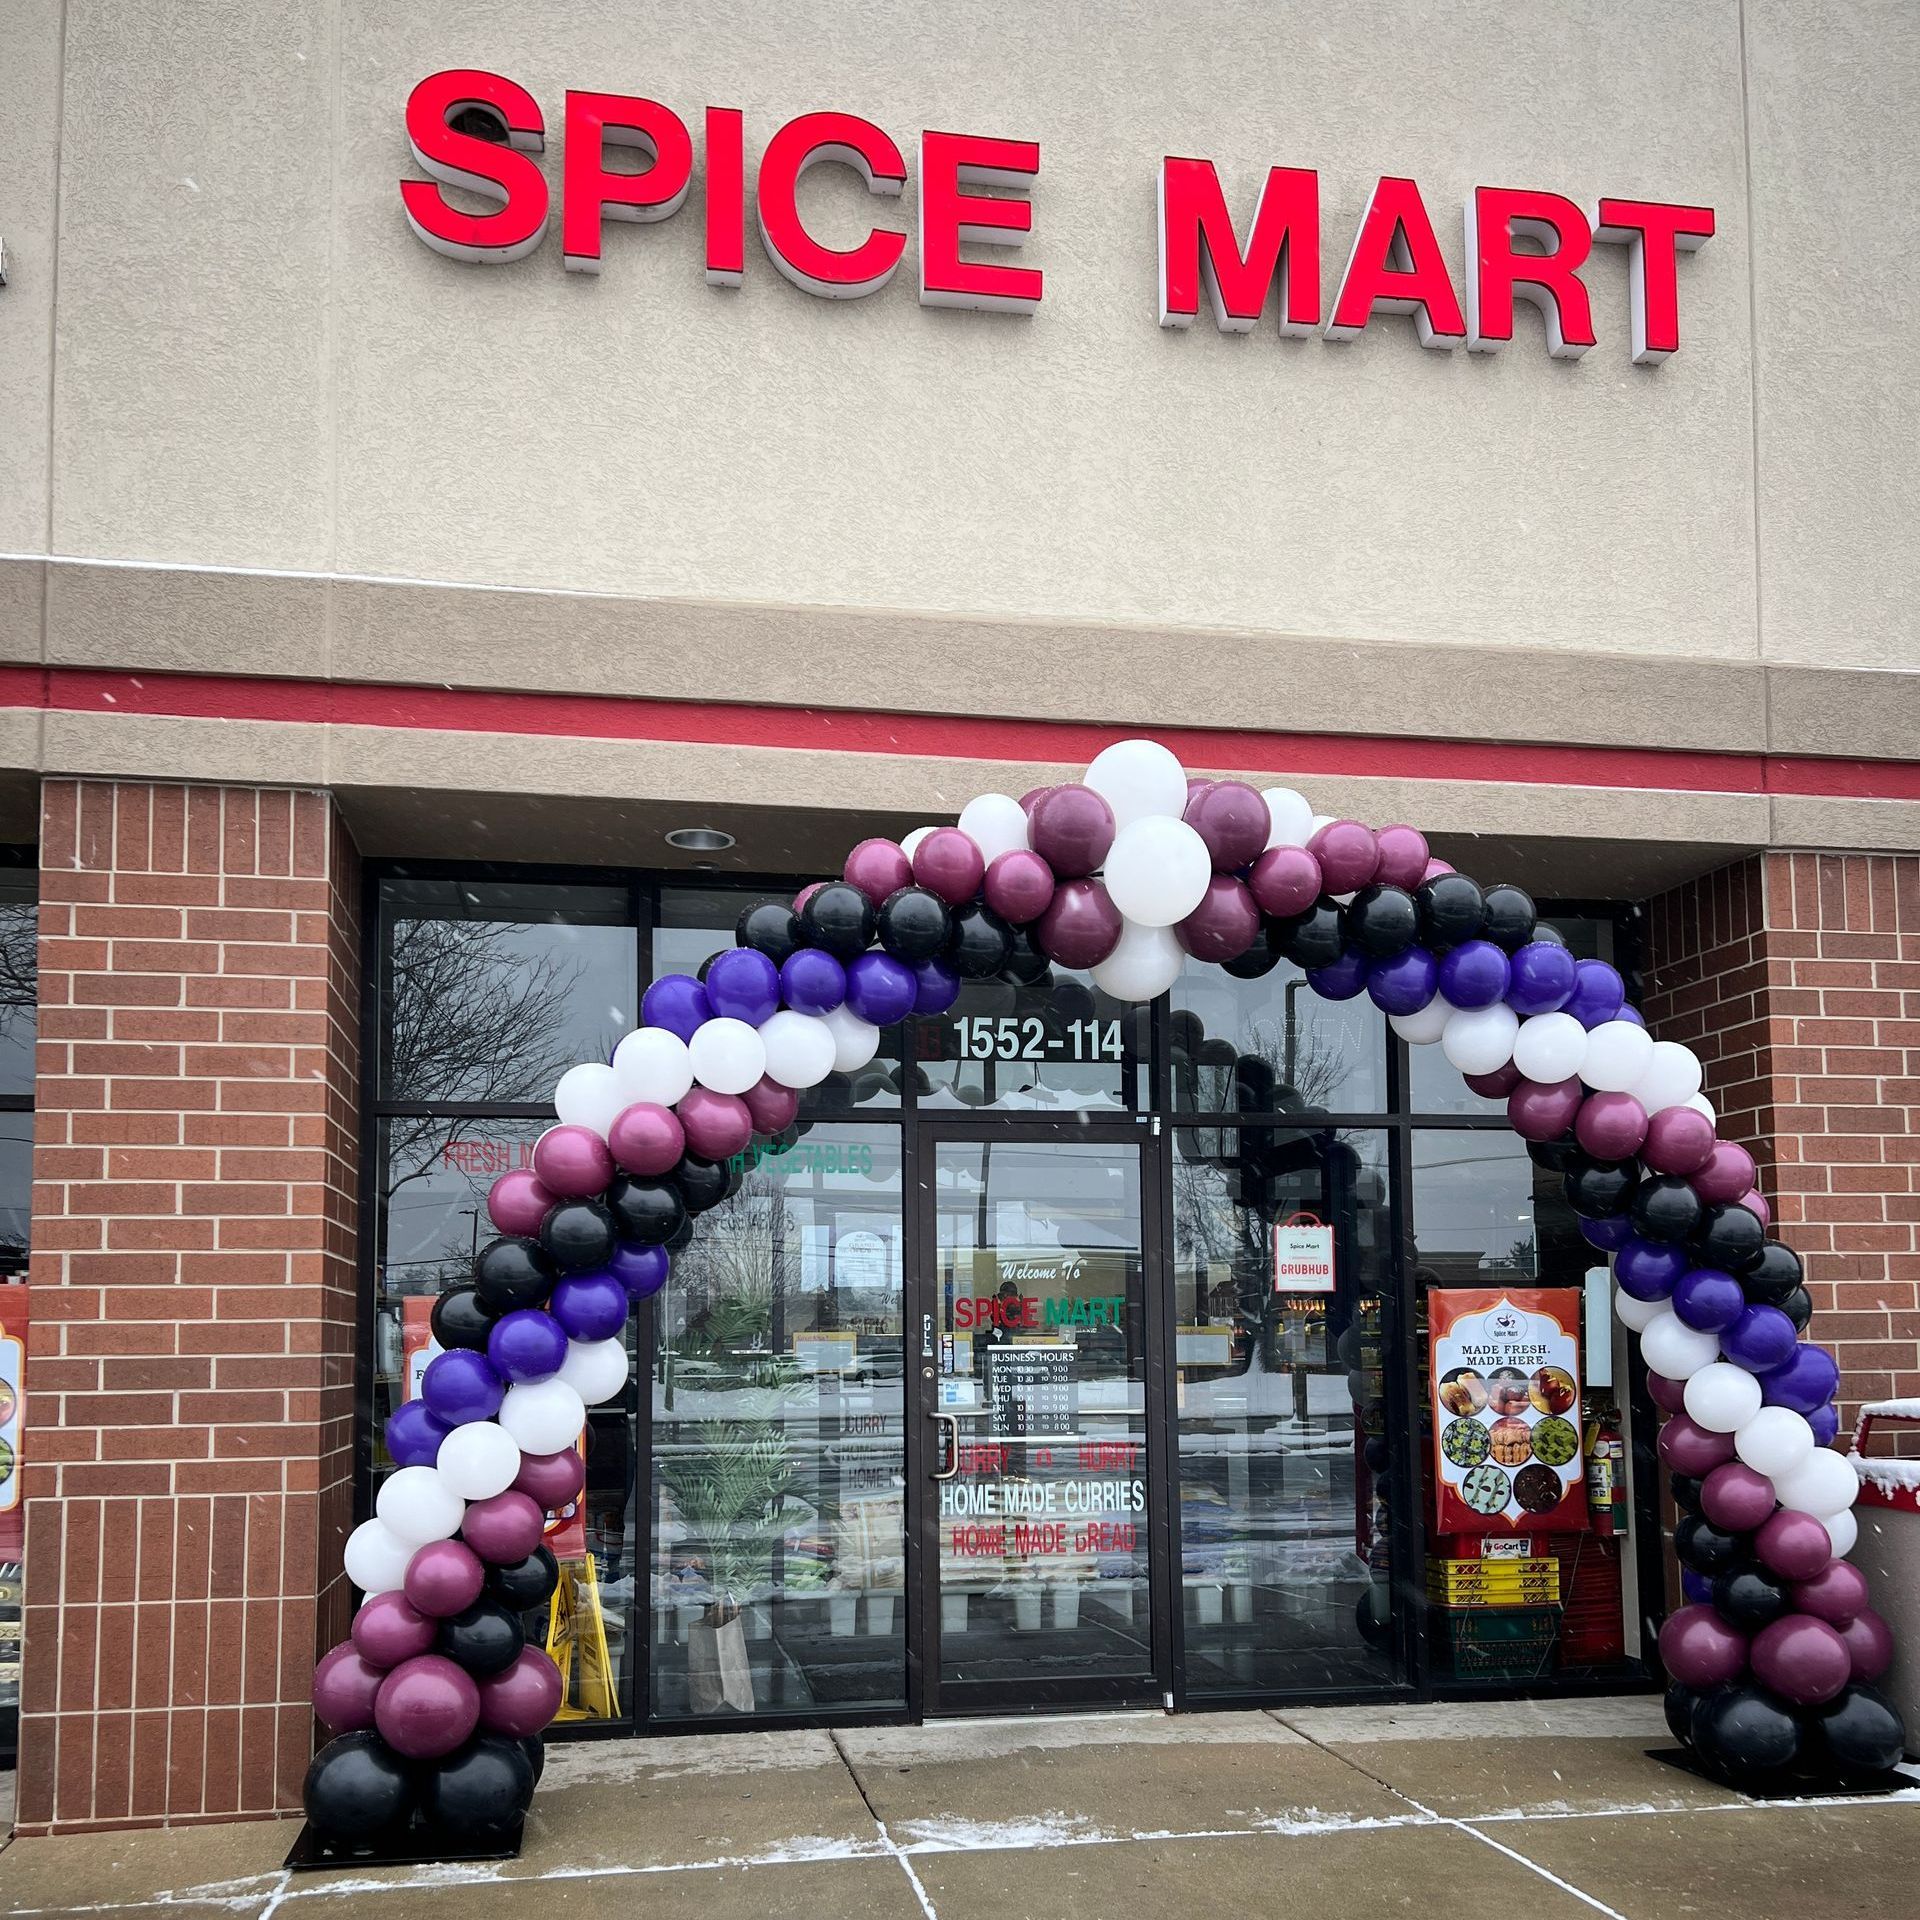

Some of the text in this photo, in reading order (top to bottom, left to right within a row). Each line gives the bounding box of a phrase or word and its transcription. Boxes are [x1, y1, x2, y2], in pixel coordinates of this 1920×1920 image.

[399, 68, 1716, 367] SPICE MART
[953, 1016, 1125, 1061] 1552-114
[1250, 1018, 1363, 1055] OPEN
[443, 1141, 511, 1173] FRESH
[751, 1143, 873, 1175] VEGETABLES
[1000, 1258, 1088, 1281] Welcome To
[1281, 1263, 1329, 1275] GRUBHUB
[955, 1296, 1126, 1329] SPICE MART
[923, 1314, 932, 1348] PULL
[1493, 1330, 1507, 1338] Spice
[991, 1352, 1075, 1362] BUSINESS HOURS
[1461, 1344, 1551, 1355] MADE FRESH.
[1466, 1355, 1548, 1366] MADE HERE.
[992, 1375, 1008, 1383] TUE
[992, 1385, 1011, 1393] WED
[992, 1404, 1005, 1412] FRI
[1078, 1441, 1137, 1471] HURRY
[940, 1479, 1145, 1516] HOME MADE CURRIES
[952, 1524, 1007, 1556] HOME
[1015, 1523, 1067, 1554] MADE
[1493, 1542, 1519, 1550] GoCart
